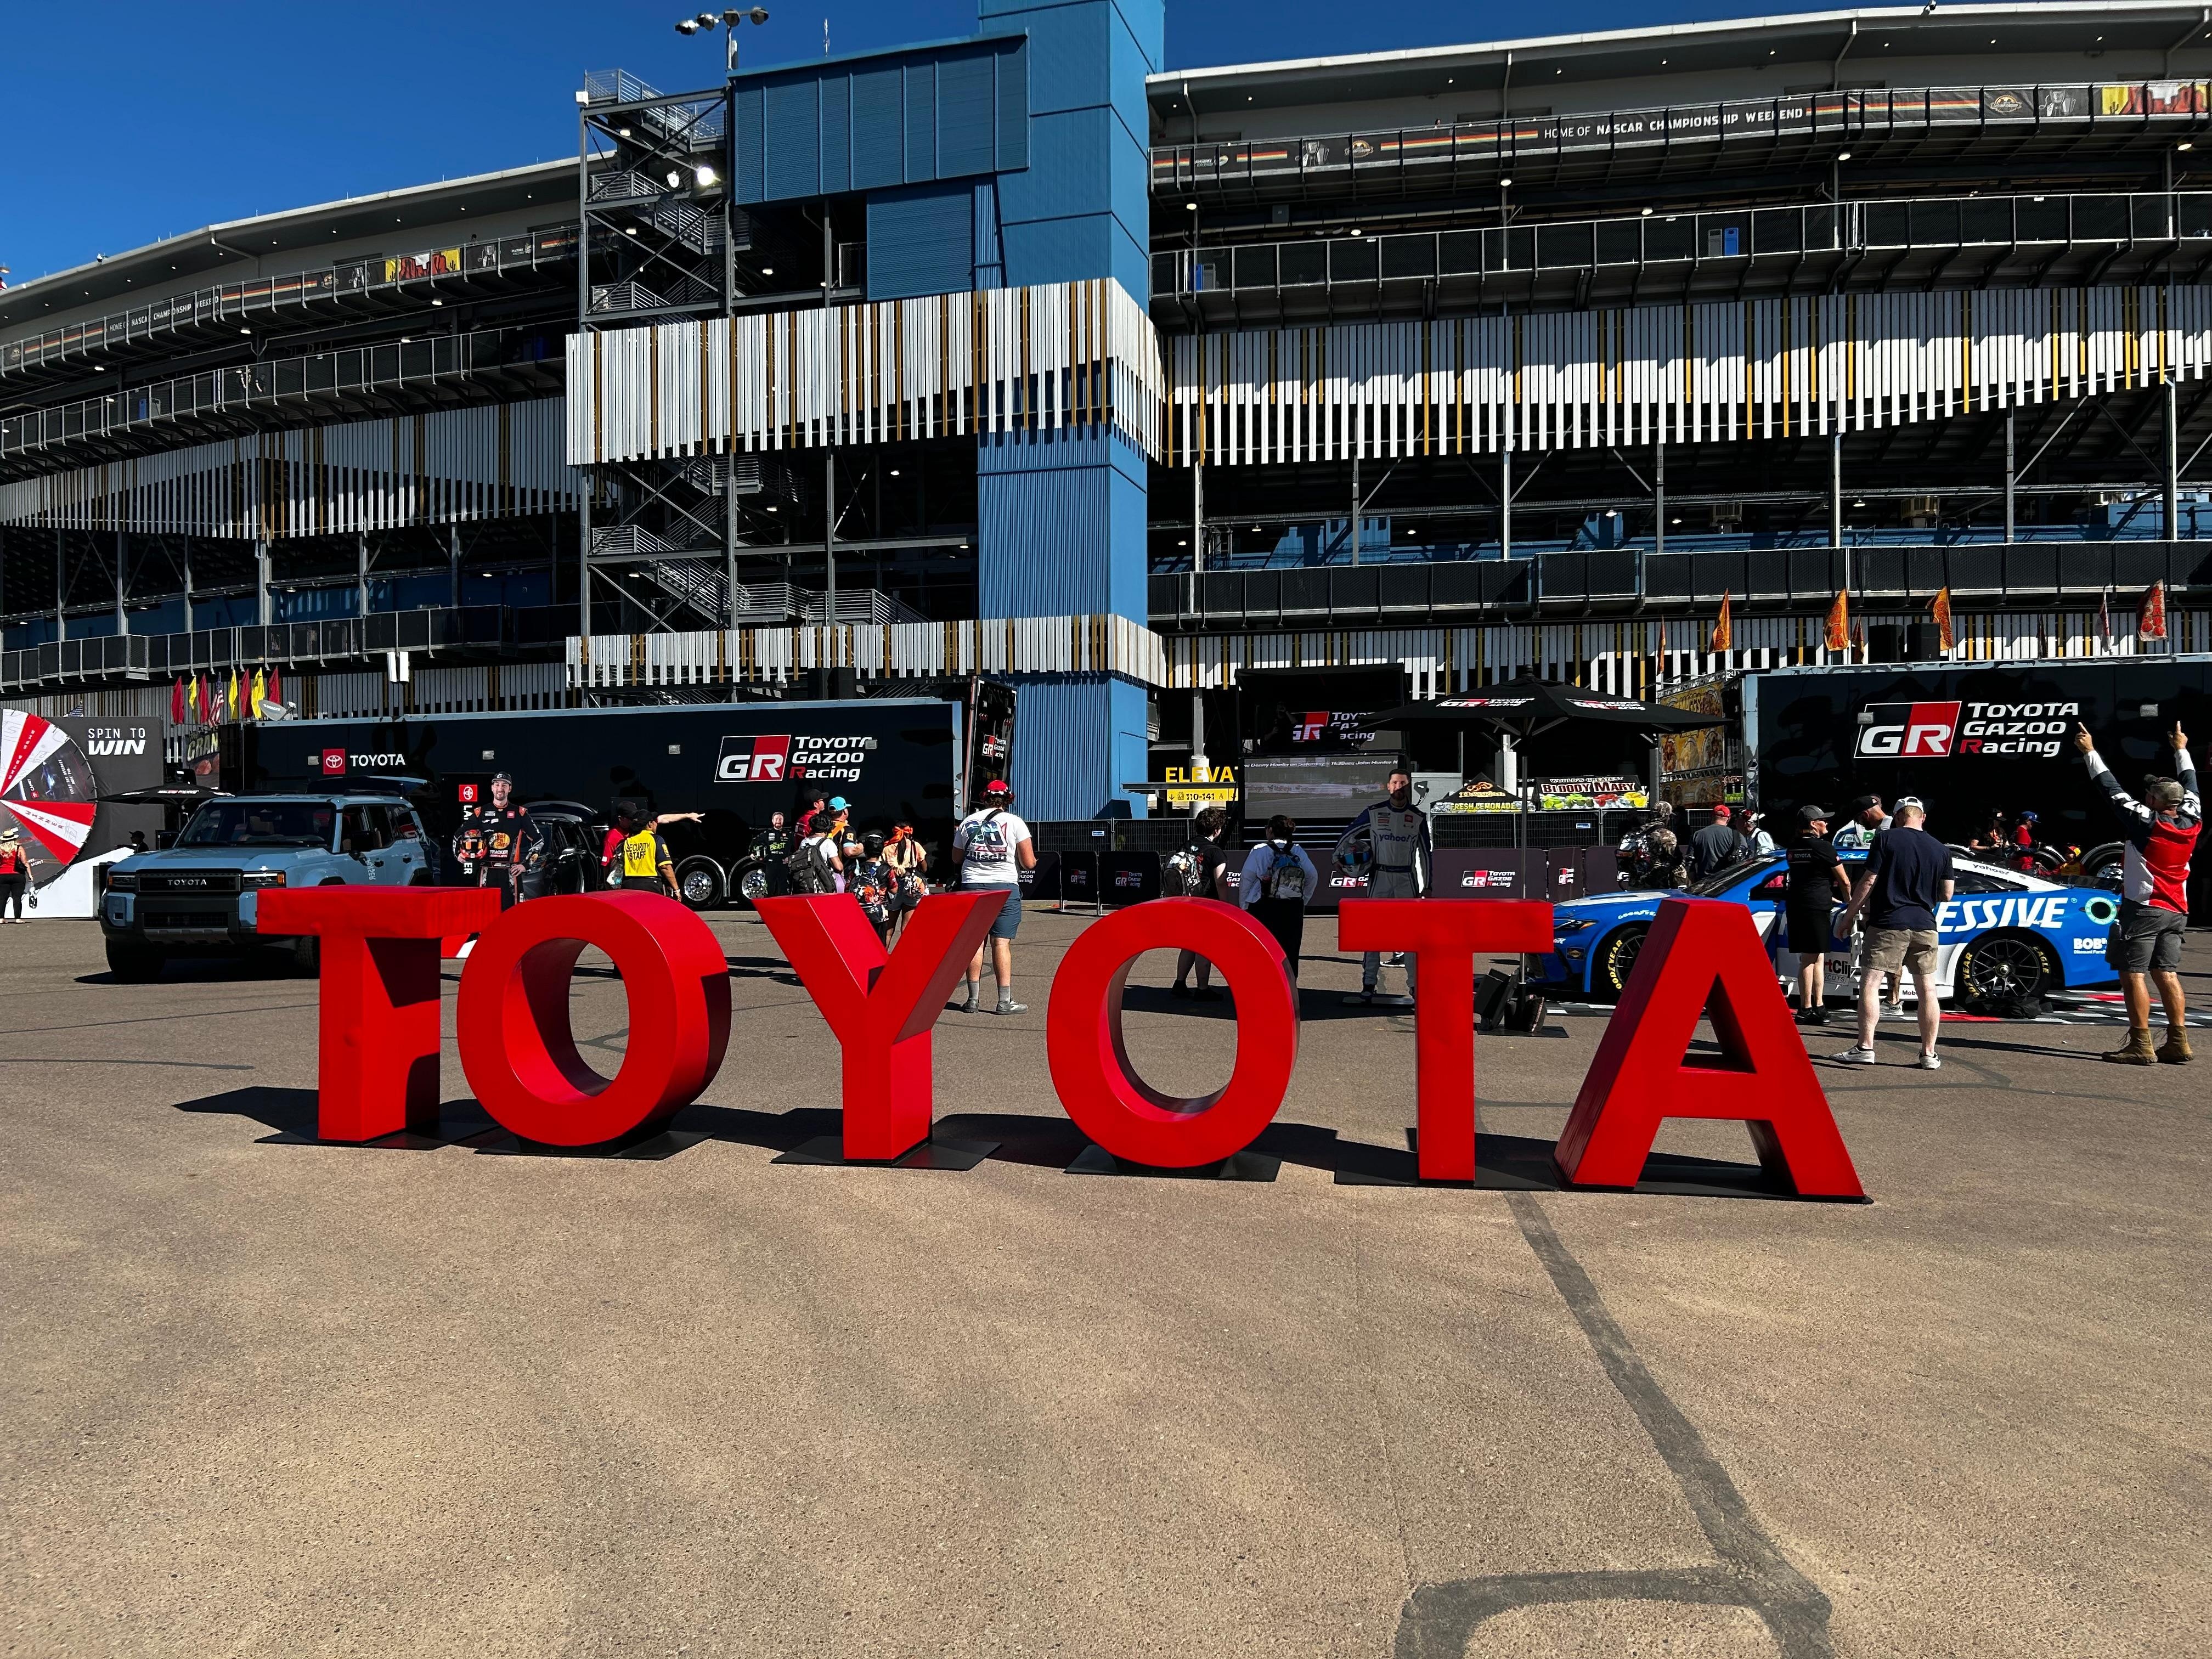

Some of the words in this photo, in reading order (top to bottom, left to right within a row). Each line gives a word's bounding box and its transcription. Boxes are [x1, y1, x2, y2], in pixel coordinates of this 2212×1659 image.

[1544, 127, 1574, 139] HOME
[1577, 126, 1590, 137] OF
[1596, 122, 1643, 136] NASCAR
[1745, 108, 1803, 123] WEEEND
[110, 322, 122, 331] HOME
[131, 315, 148, 326] NASCA
[153, 303, 191, 320] CHAMPONSHIP
[1967, 702, 2079, 718] TOYOTA
[1330, 721, 1359, 730] GAZ
[1963, 721, 2067, 736] GAZOO
[88, 727, 120, 739] SPIN
[130, 727, 146, 738] TO
[1340, 730, 1375, 741] acing
[1860, 724, 1951, 754] GR
[88, 740, 146, 755] WIN
[187, 732, 219, 762] GRAN
[983, 743, 994, 755] GR
[1960, 738, 2061, 757] Racing
[349, 753, 406, 767] TOYOTA
[792, 751, 864, 764] GAZOO
[719, 754, 784, 778] GR
[789, 766, 860, 782] Racing
[1166, 766, 1238, 783] ELEVA
[1542, 783, 1590, 793] BLOODY
[1593, 781, 1635, 792] MARY
[25, 810, 64, 829] WINNER
[1379, 833, 1411, 843] yahoo!
[627, 842, 650, 853] SECURITY
[629, 851, 646, 861] STAFF
[1972, 863, 2010, 876] yahoo!
[1115, 877, 1127, 886] GR
[1330, 877, 1356, 887] GR
[1463, 877, 1486, 886] GR
[1617, 909, 1656, 920] GOODYE
[1935, 897, 2068, 933] ESSIVE
[1607, 939, 1623, 990] OODYEAR
[1825, 974, 1846, 983] CUTS
[257, 887, 1864, 1197] TOYOTA
